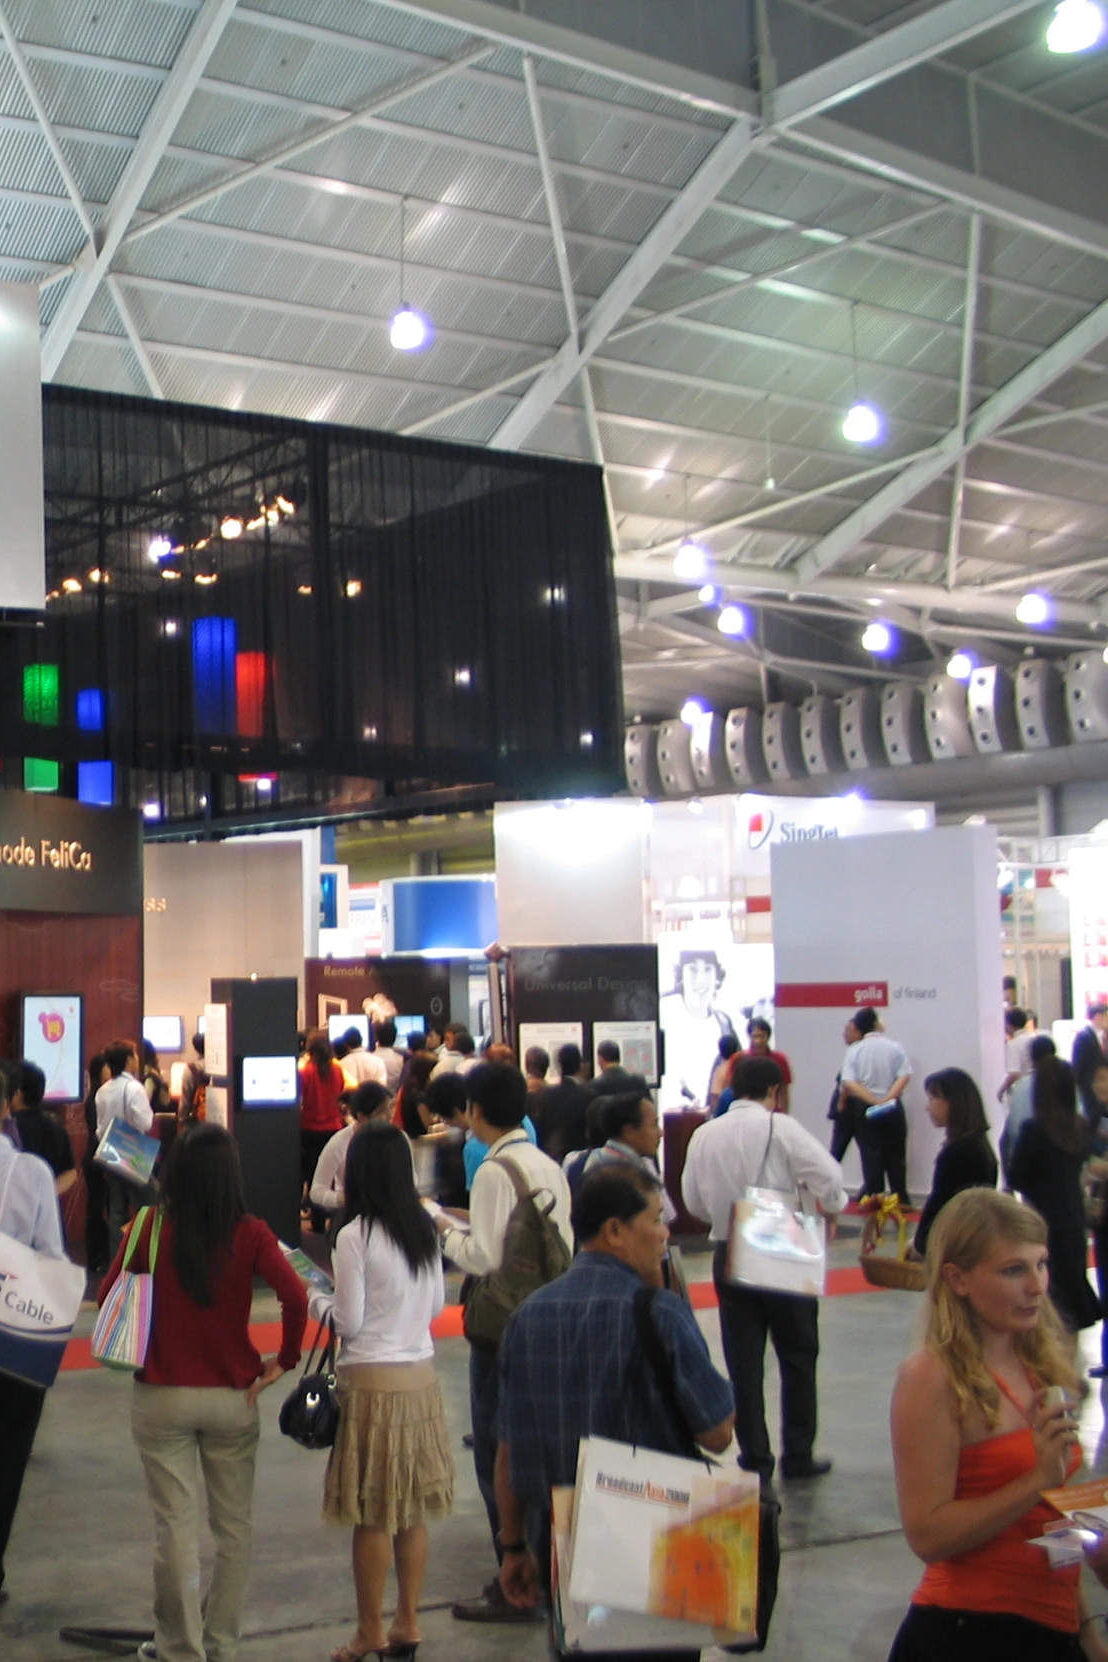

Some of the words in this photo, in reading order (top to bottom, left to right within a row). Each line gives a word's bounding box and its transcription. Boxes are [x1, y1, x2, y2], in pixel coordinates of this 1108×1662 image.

[40, 839, 92, 871] FeliCa
[854, 985, 884, 1004] golla
[4, 1291, 54, 1326] Cable
